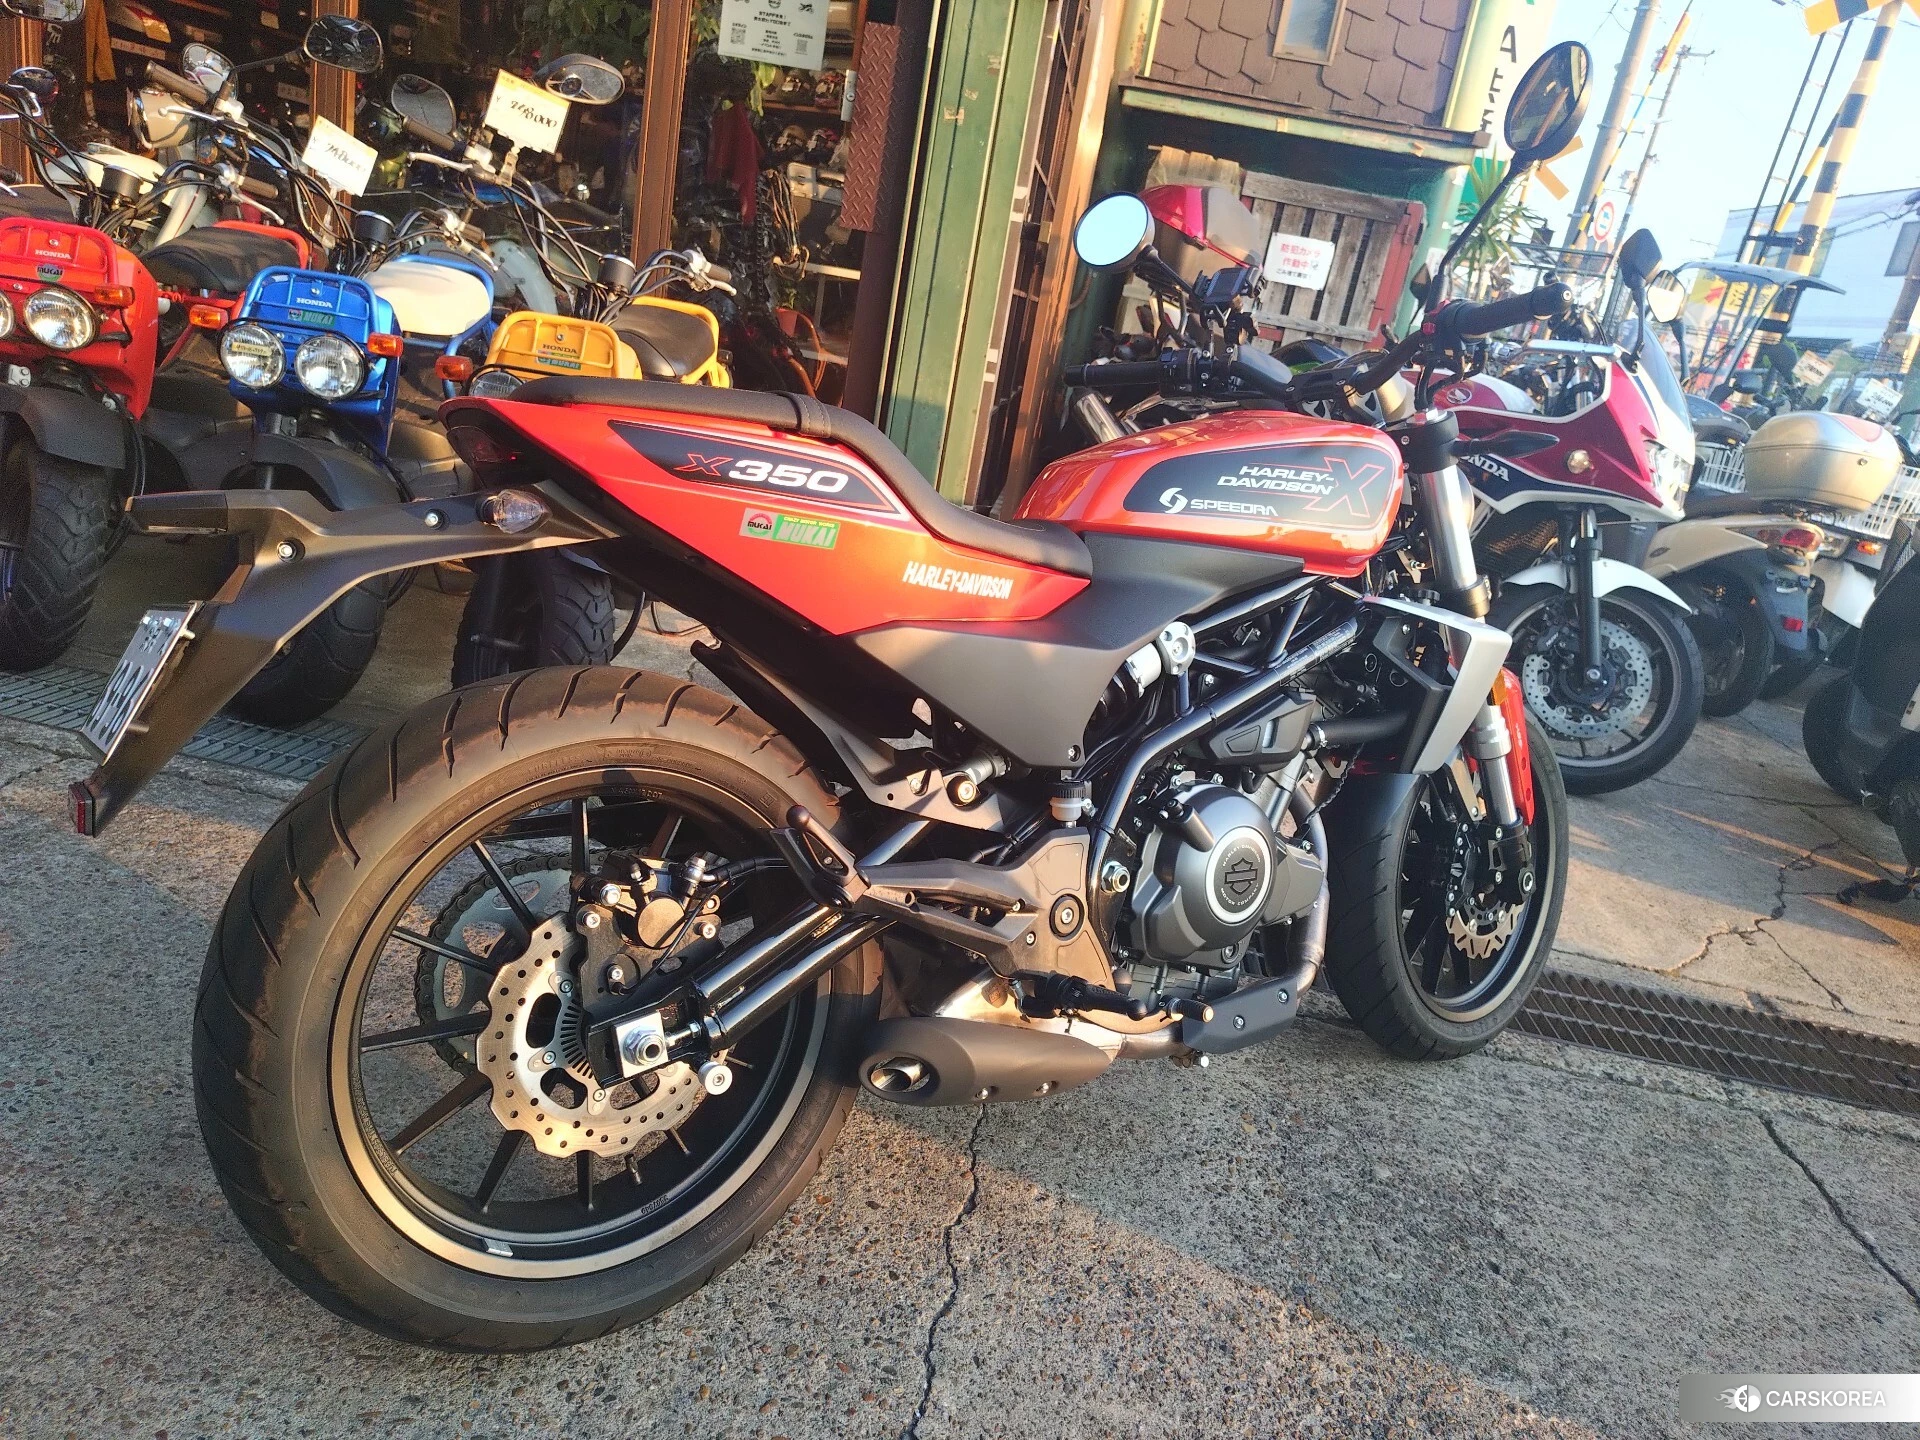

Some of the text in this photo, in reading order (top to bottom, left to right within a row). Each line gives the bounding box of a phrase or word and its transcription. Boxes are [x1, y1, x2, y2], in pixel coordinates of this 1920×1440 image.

[35, 249, 71, 260] HONDA
[296, 297, 333, 309] HONDA
[542, 343, 578, 355] HONDA
[1239, 465, 1335, 483] HARLEY-
[1216, 476, 1334, 495] DAVIDSON
[1190, 498, 1279, 517] SPEEDRA
[747, 520, 772, 530] MUKAI
[775, 521, 837, 547] MUKAI
[902, 560, 1014, 600] HARLEY-DAVIDSON
